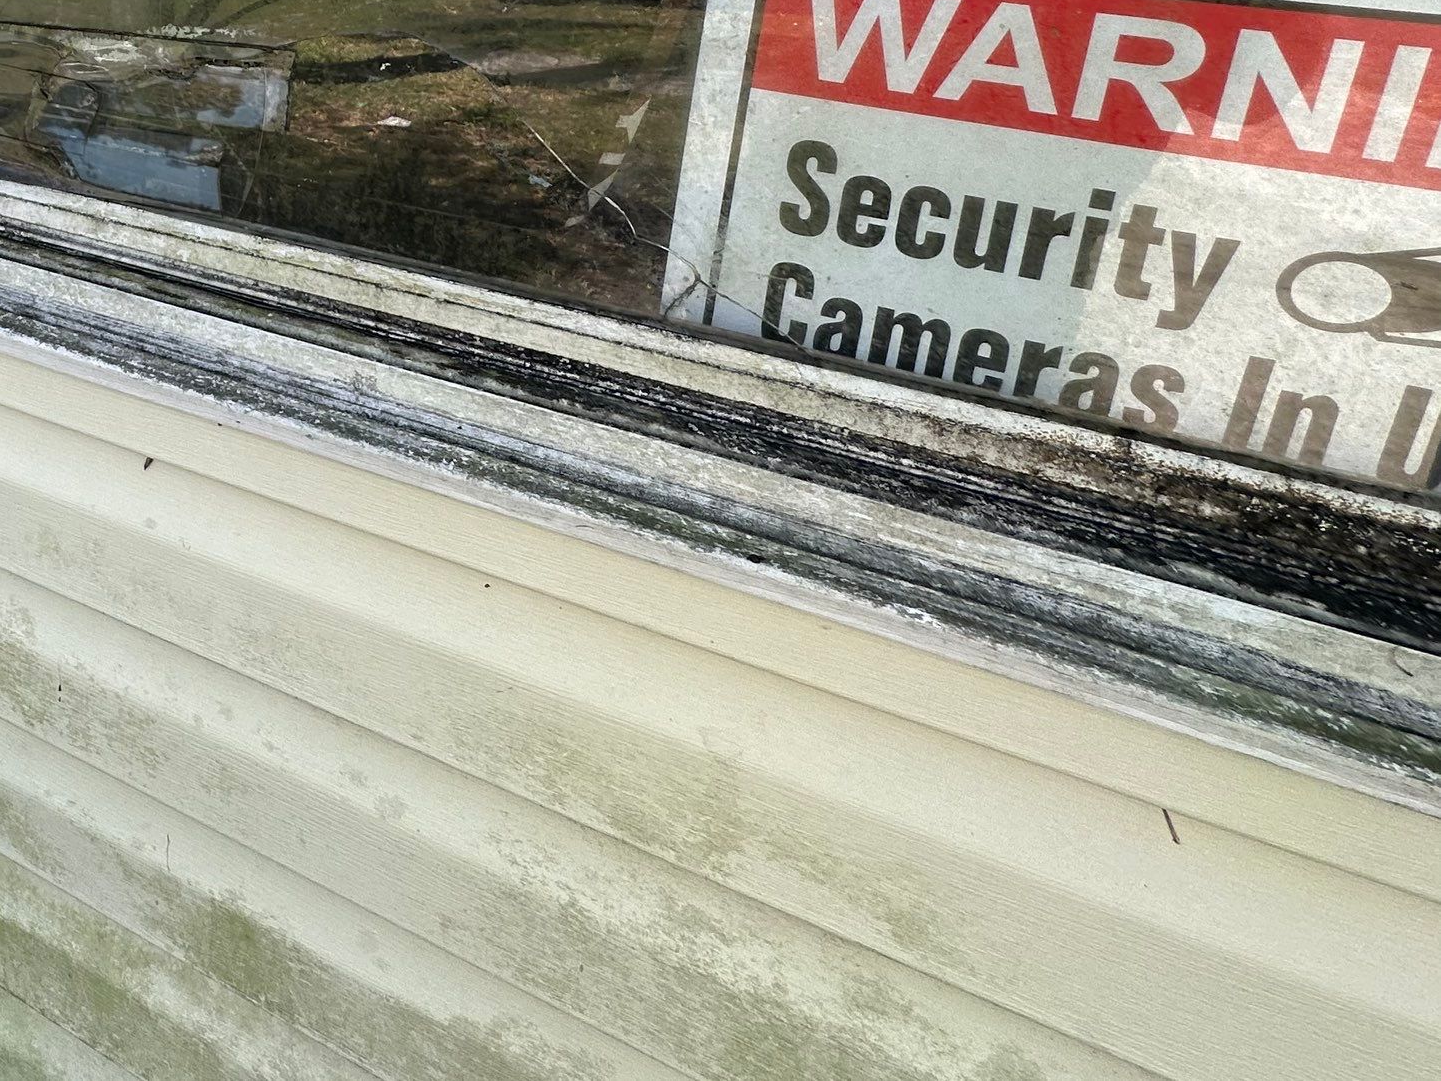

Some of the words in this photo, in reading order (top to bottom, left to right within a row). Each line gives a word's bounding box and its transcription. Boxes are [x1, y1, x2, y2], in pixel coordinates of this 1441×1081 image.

[778, 139, 1241, 331] Security
[761, 261, 1185, 433] Cameras
[1221, 355, 1340, 465] In
